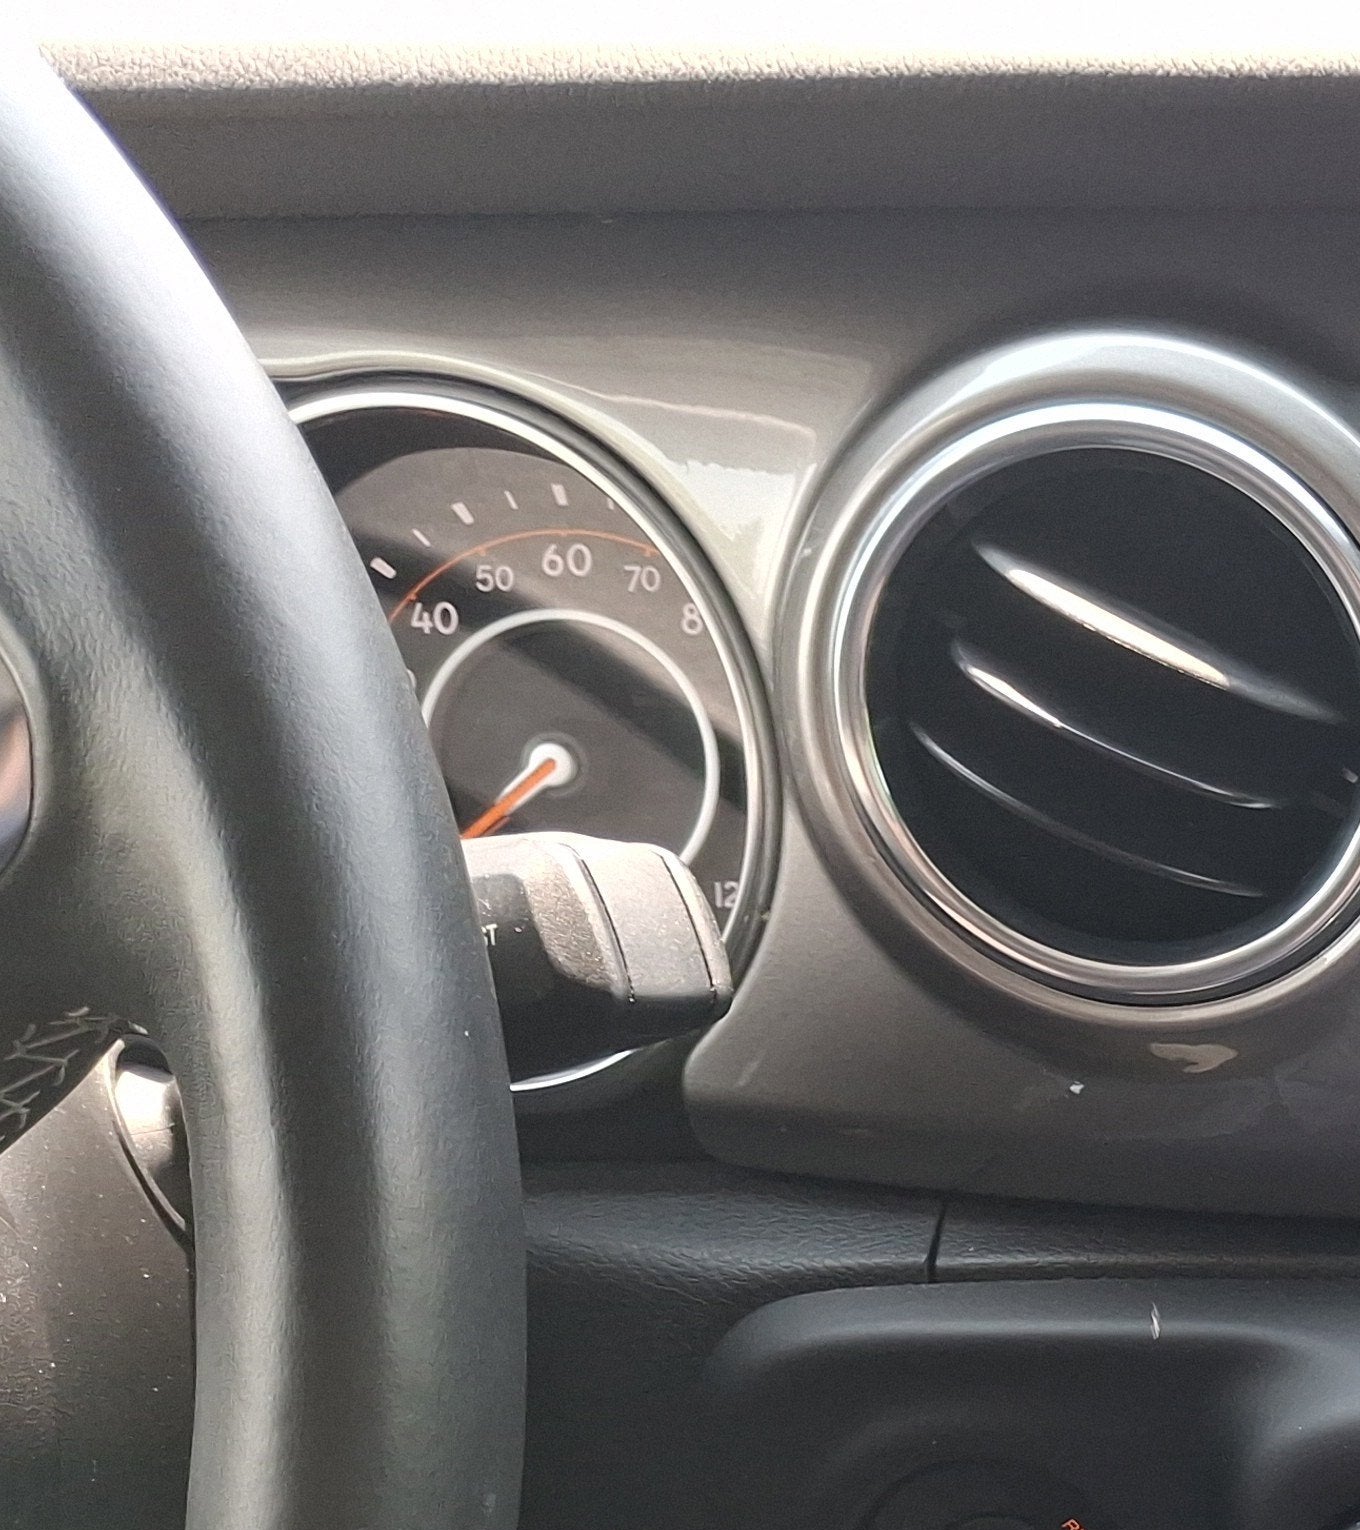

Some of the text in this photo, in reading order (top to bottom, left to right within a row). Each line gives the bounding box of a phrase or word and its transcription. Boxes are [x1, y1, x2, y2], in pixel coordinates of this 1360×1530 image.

[540, 543, 593, 577] 60
[474, 564, 515, 593] 50
[622, 565, 662, 593] 70
[409, 601, 460, 636] 40
[681, 601, 704, 635] 8
[713, 880, 741, 908] 12
